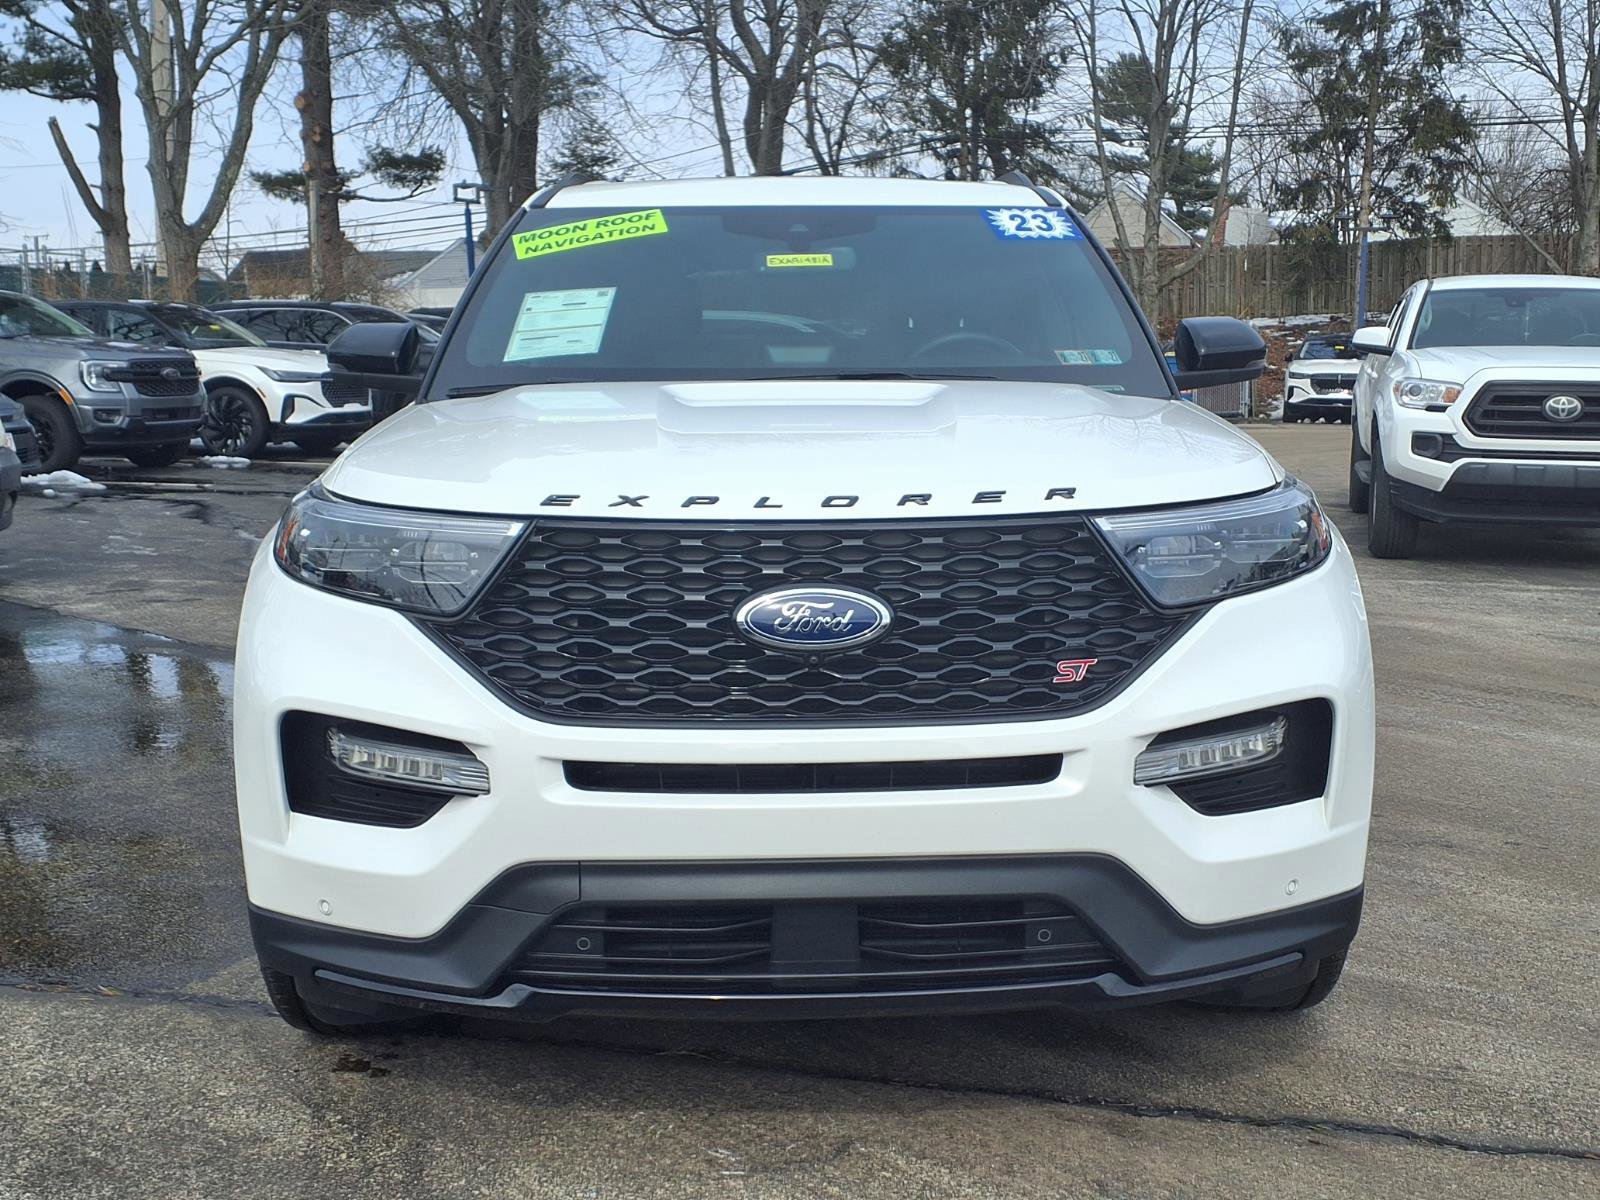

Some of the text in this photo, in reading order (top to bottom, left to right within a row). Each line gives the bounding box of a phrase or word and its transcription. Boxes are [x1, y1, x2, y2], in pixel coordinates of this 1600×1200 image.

[518, 212, 657, 244] MOON ROOF
[1009, 214, 1053, 231] 23
[524, 223, 656, 254] NAVIGATION
[539, 487, 1077, 509] EXPLORER
[773, 600, 855, 634] Ford
[1052, 658, 1098, 683] ST
